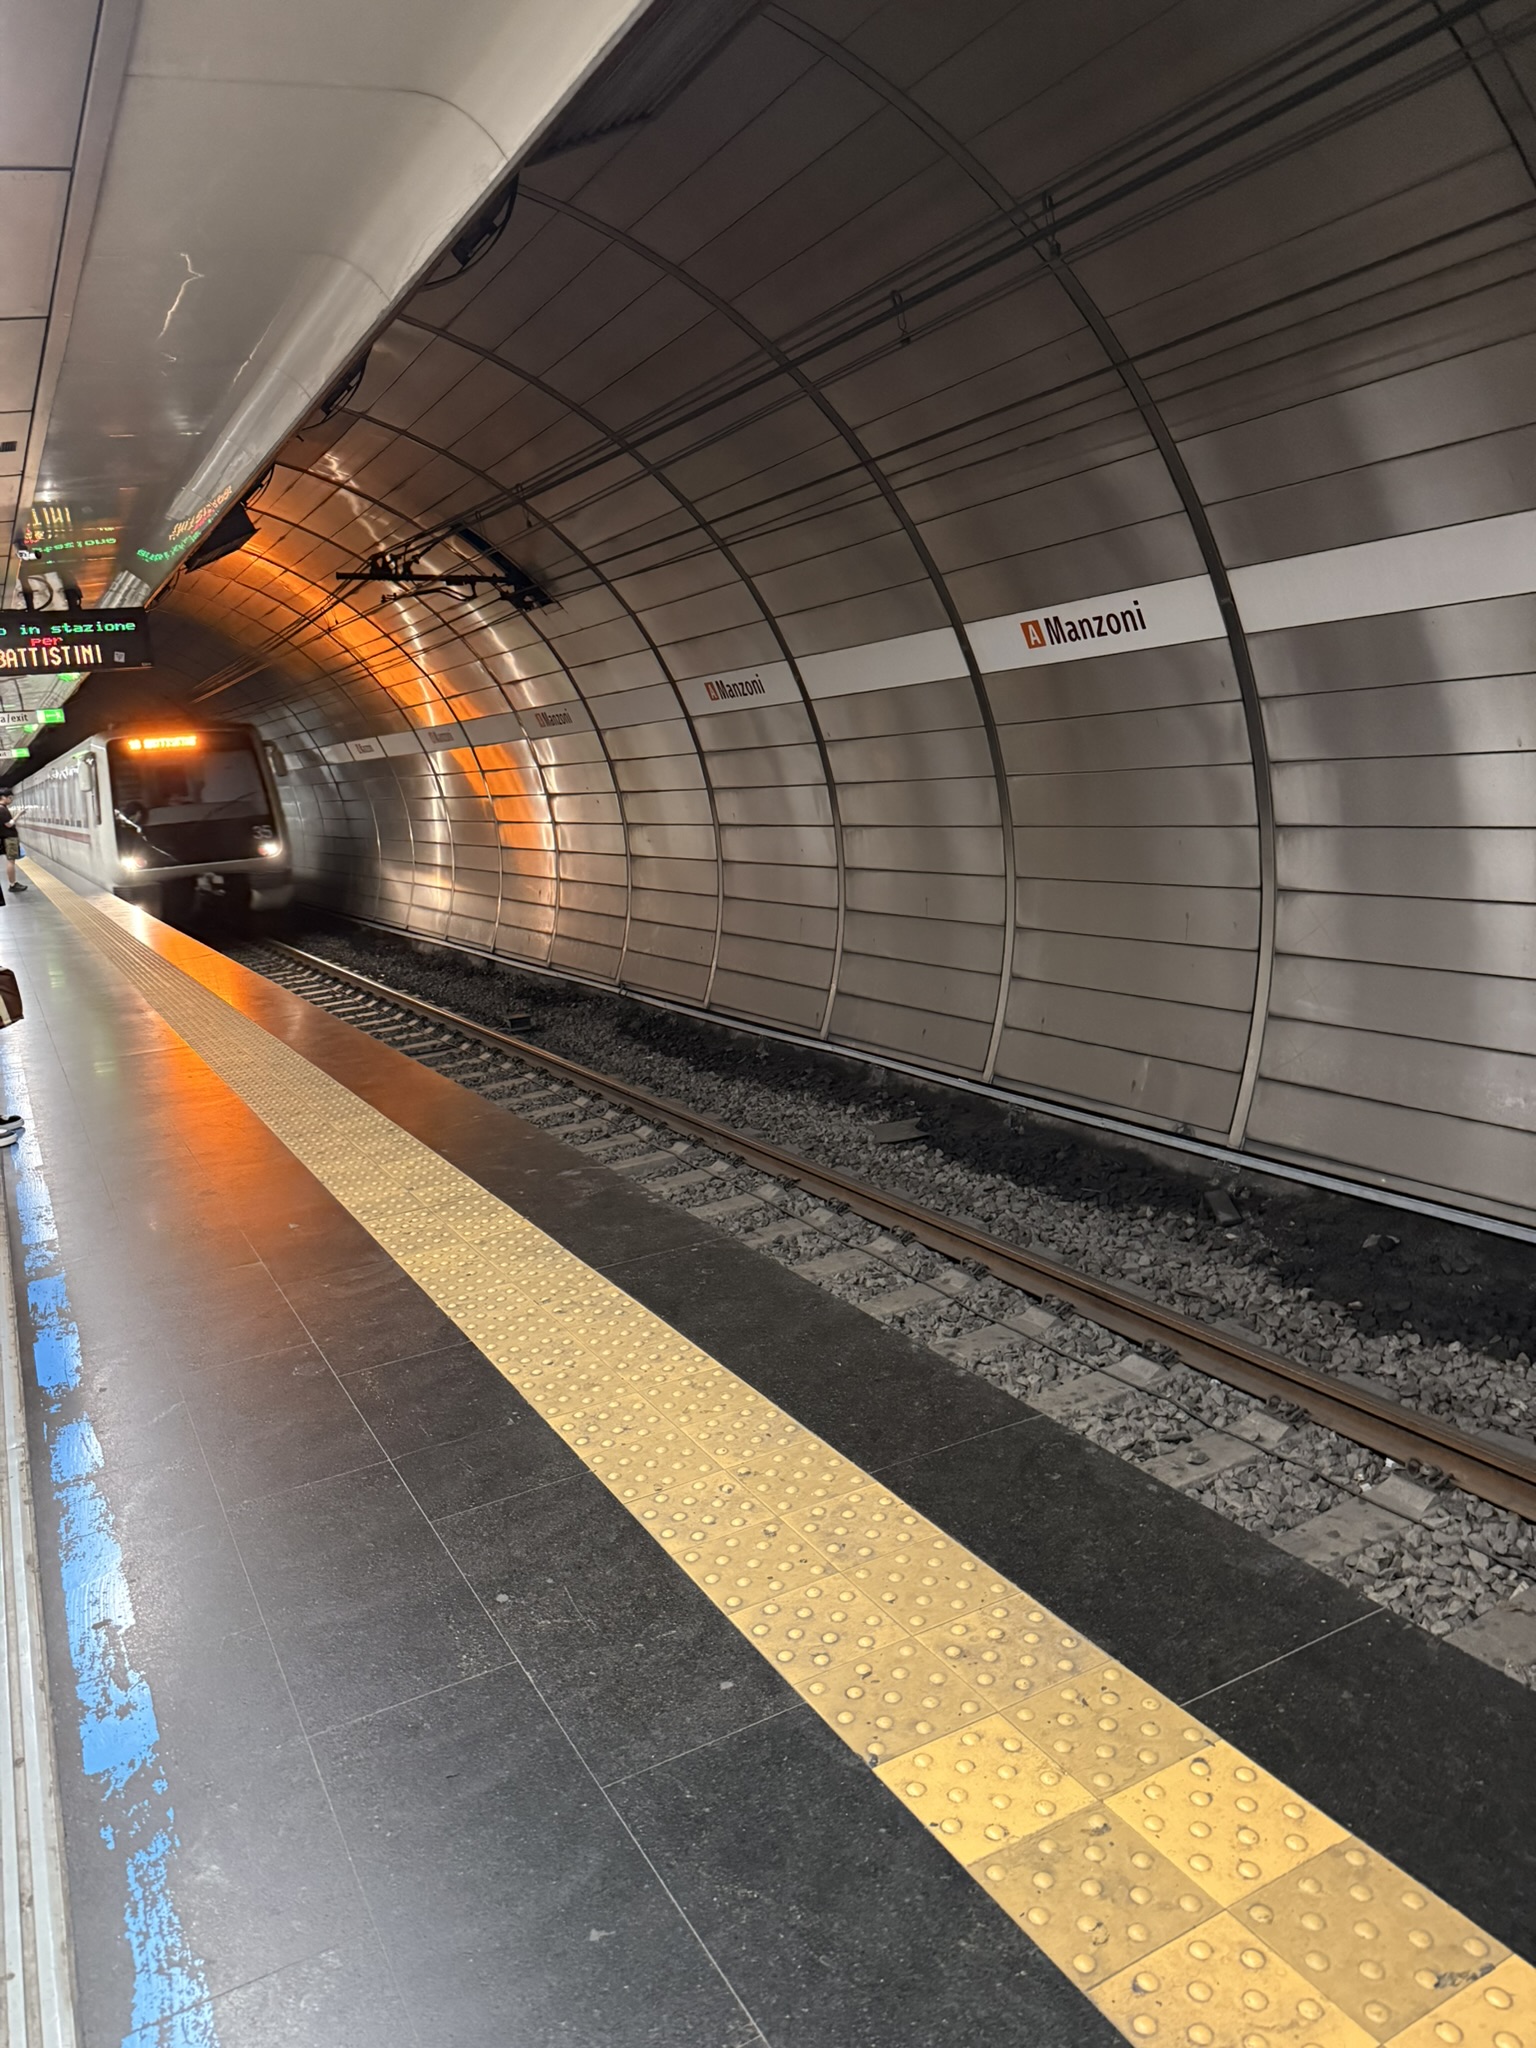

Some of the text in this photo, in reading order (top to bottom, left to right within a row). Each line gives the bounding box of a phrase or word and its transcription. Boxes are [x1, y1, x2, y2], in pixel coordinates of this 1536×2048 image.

[20, 624, 40, 635] in
[51, 621, 136, 634] stazione
[1044, 600, 1147, 645] Manzoni
[30, 636, 63, 646] per
[715, 673, 765, 700] Manzoni
[252, 824, 273, 840] 35
